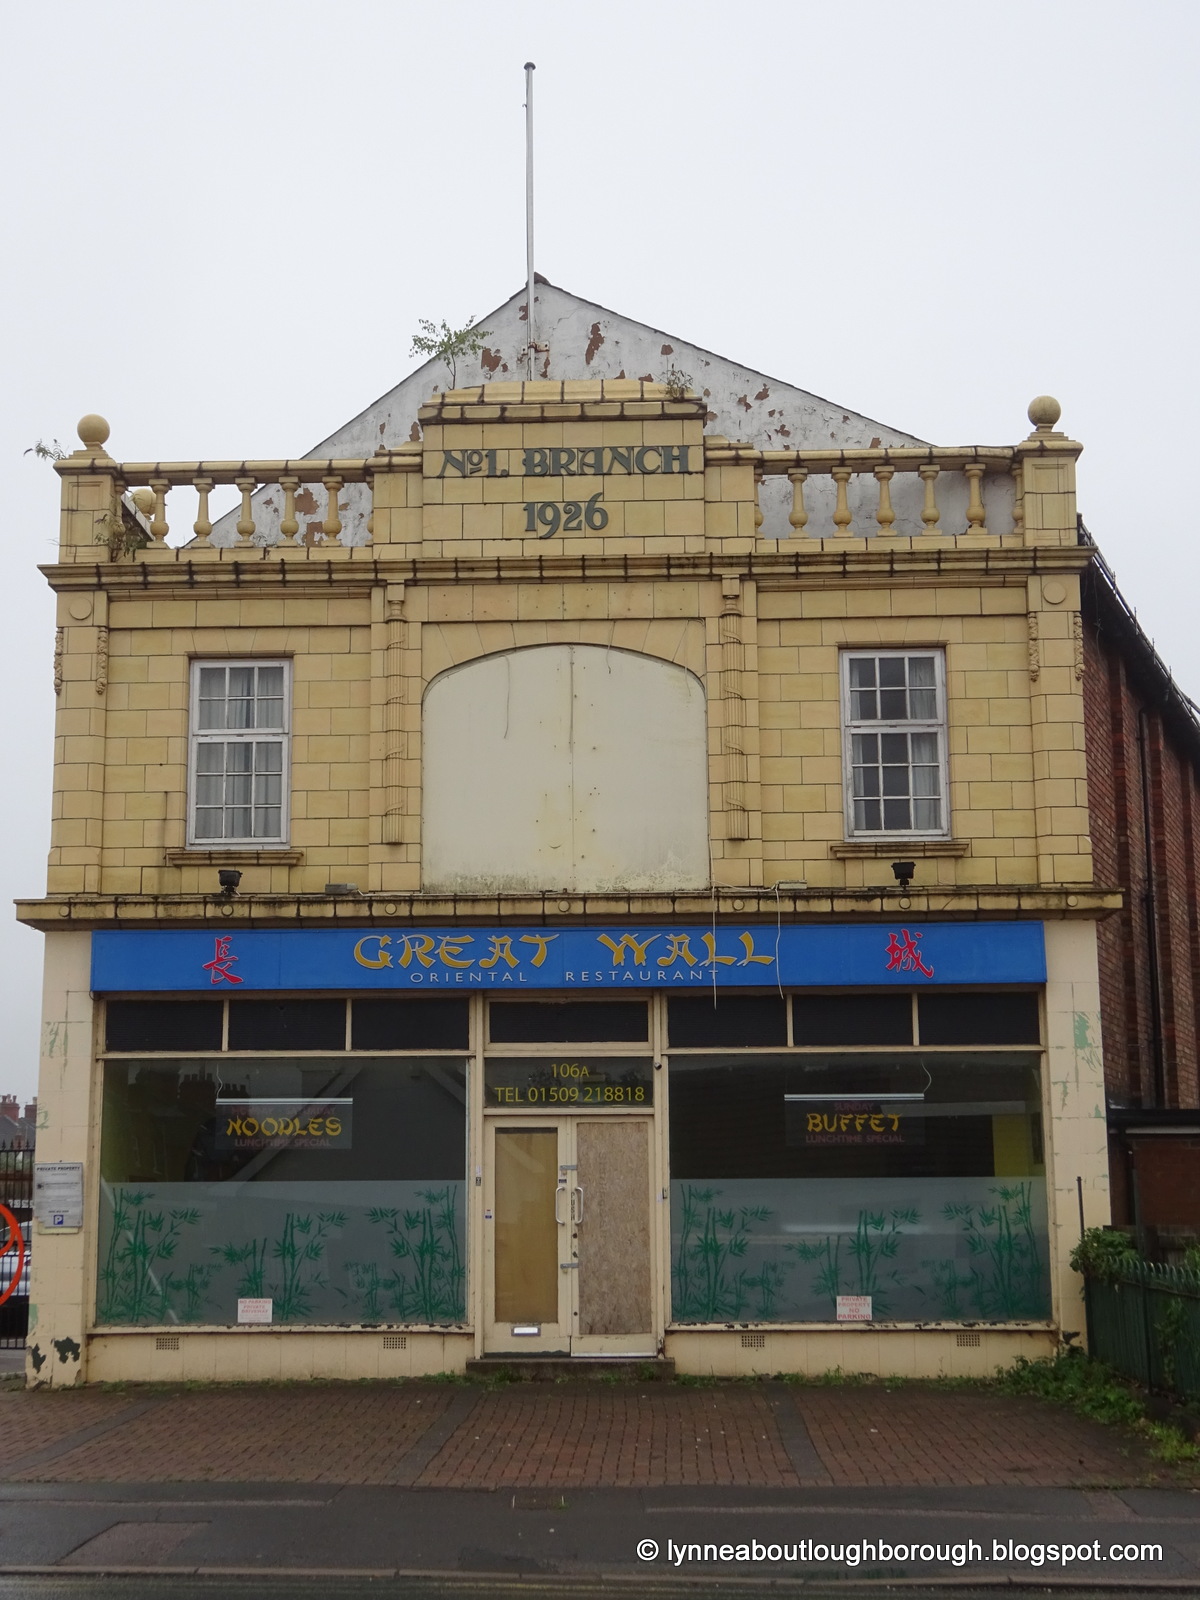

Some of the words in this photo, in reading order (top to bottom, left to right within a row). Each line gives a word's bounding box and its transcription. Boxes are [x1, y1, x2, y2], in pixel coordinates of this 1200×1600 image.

[522, 446, 690, 476] BRANCH
[523, 492, 608, 539] 1926
[202, 935, 243, 984] 長
[353, 933, 560, 969] GREAT
[597, 931, 776, 967] WALL
[410, 971, 528, 983] ORIENTAL
[565, 969, 719, 982] RESTAURANT
[551, 1063, 590, 1078] 106A
[494, 1087, 524, 1102] TEL
[528, 1087, 579, 1102] 01509
[584, 1086, 645, 1102] 218818
[226, 1115, 342, 1137] NOODLES
[806, 1112, 903, 1133] BUFFET
[806, 1134, 862, 1144] LUNCHTIME
[866, 1134, 905, 1143] SPECIAL
